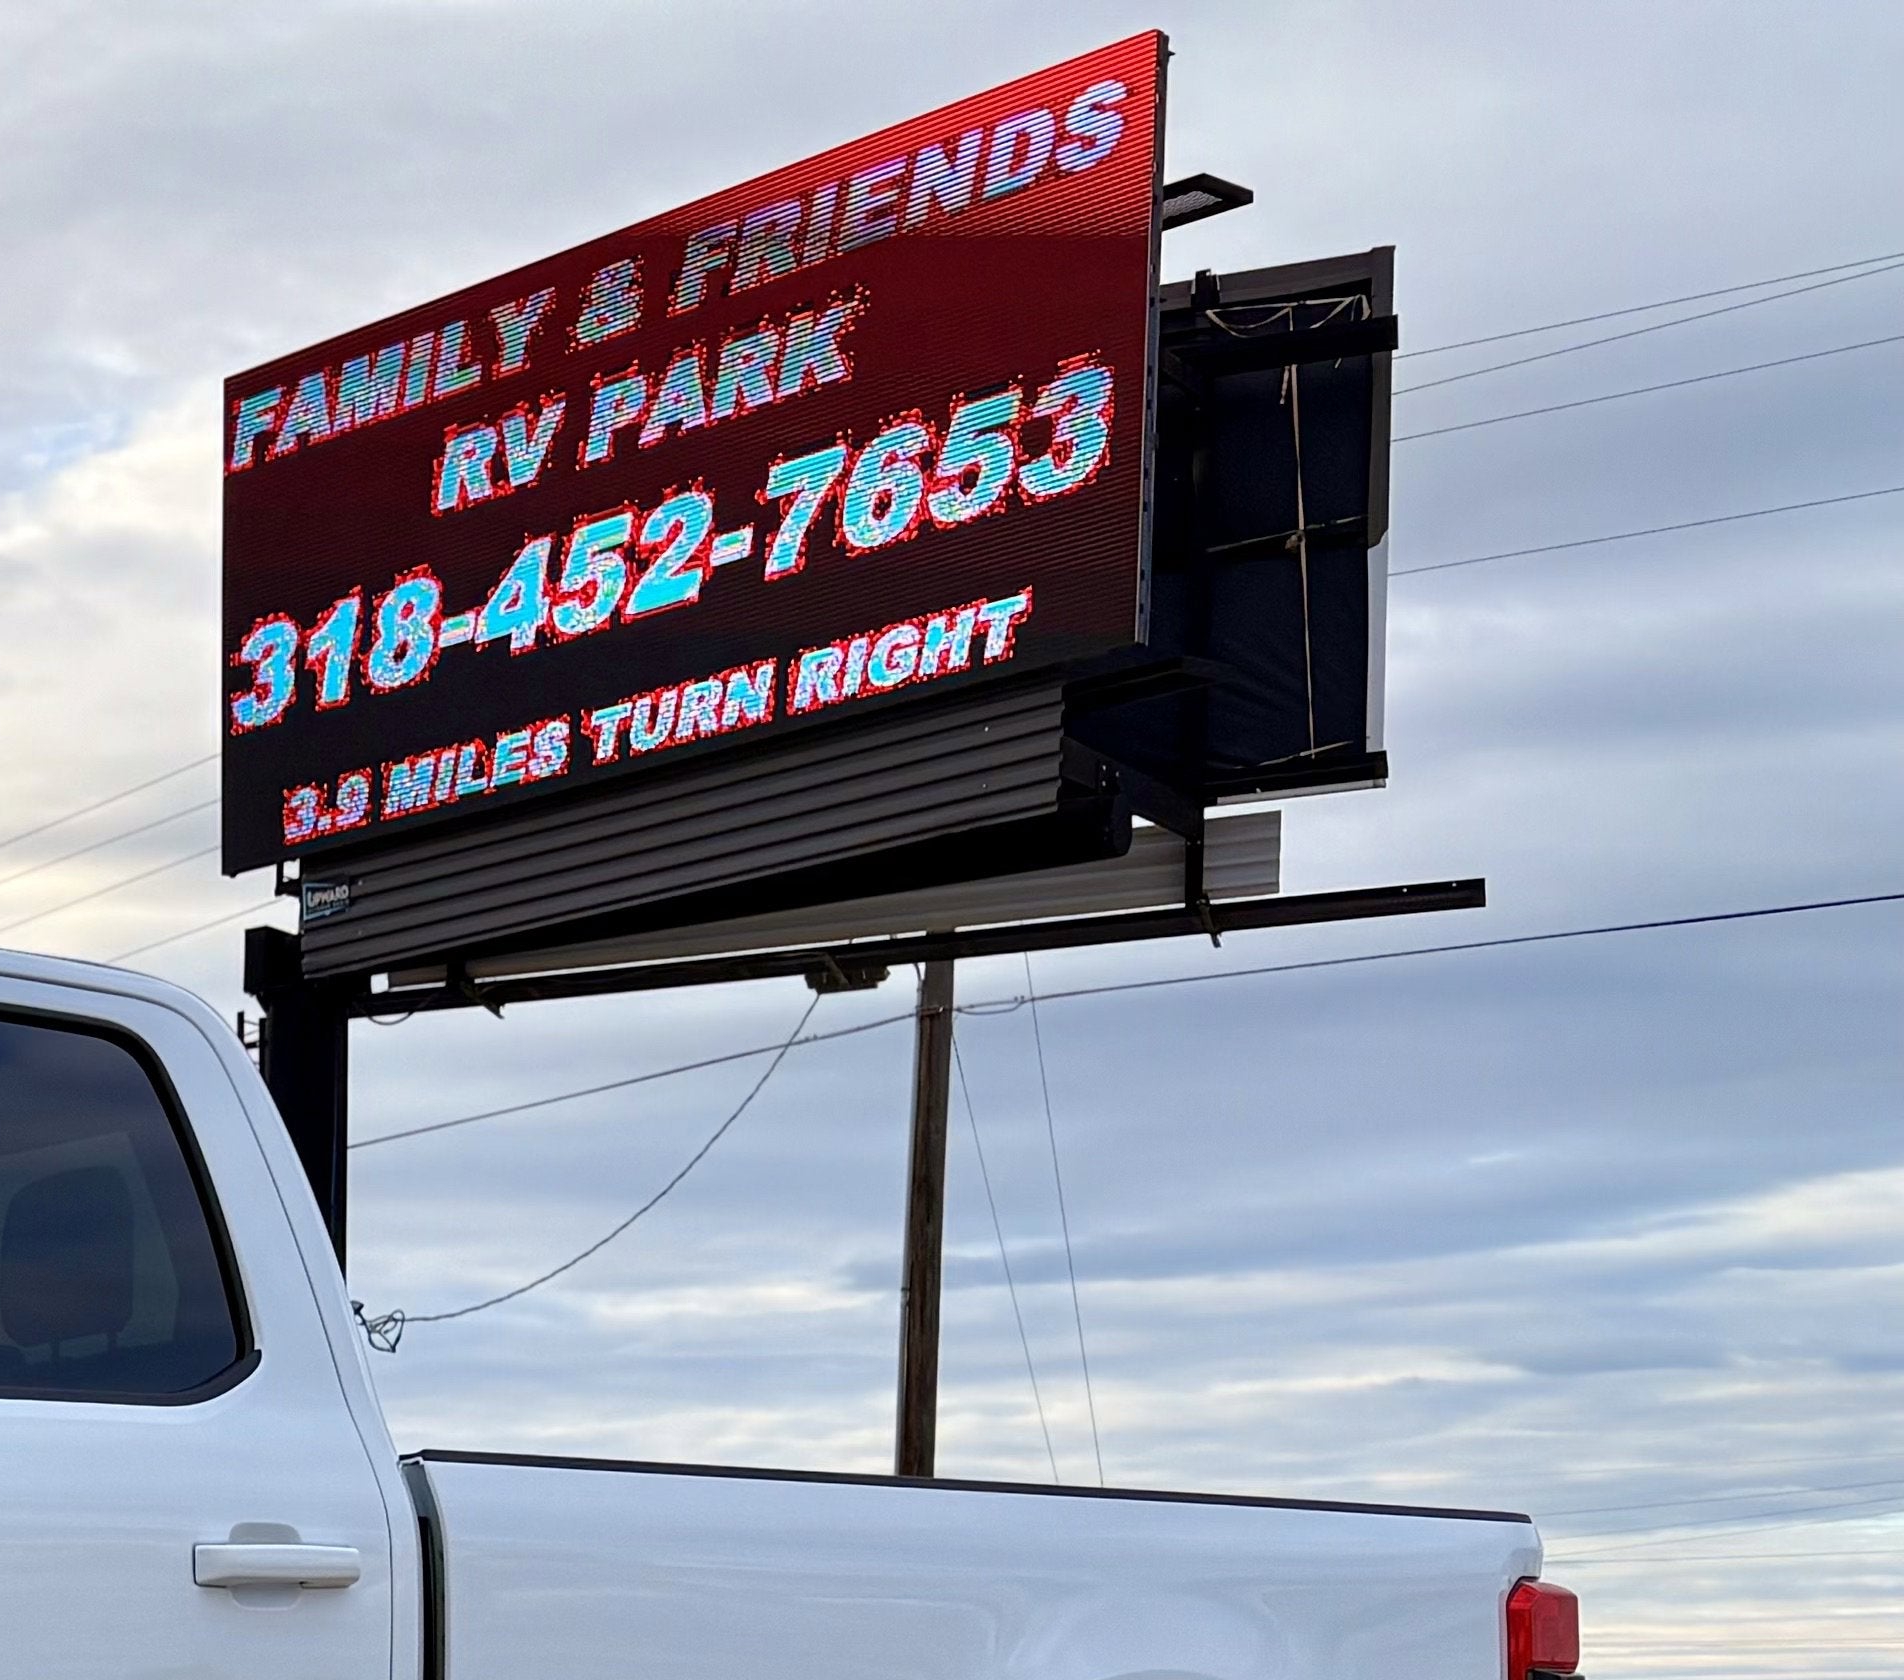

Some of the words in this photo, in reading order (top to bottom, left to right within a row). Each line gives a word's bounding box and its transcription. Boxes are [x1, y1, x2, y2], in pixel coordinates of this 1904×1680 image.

[228, 286, 556, 474] FAMILY
[570, 255, 644, 350] &
[668, 79, 1128, 318] FRIENDS
[432, 392, 567, 516] RV
[577, 285, 864, 468] PARK
[232, 355, 1114, 732] 318-452-7653
[284, 767, 372, 844] 3.9
[382, 716, 570, 820] MILES
[584, 661, 777, 765] TURN
[788, 587, 1032, 714] RIGHT
